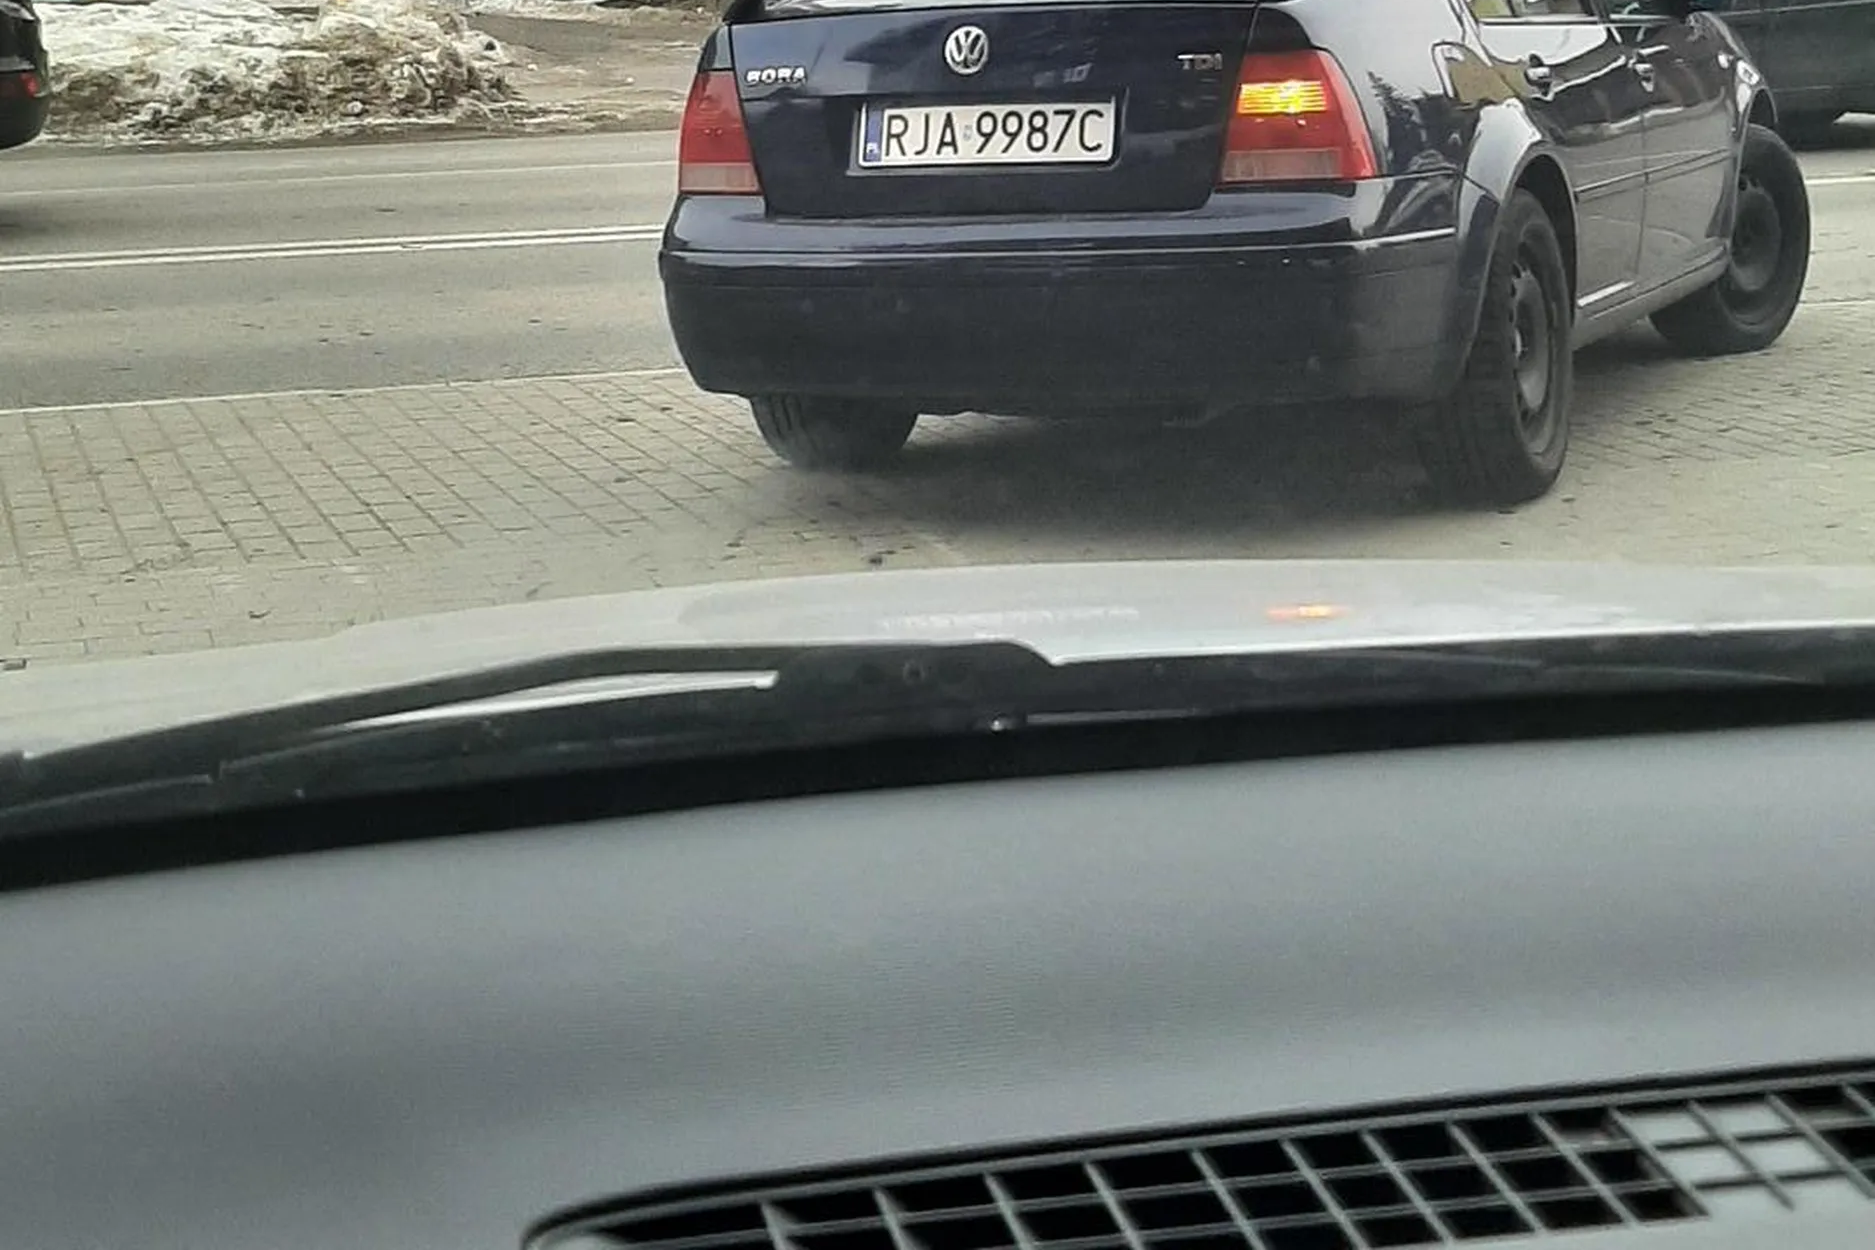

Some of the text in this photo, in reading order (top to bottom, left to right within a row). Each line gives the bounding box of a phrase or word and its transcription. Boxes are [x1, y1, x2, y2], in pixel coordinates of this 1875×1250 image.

[1177, 53, 1222, 70] TDI
[746, 66, 806, 85] BORA
[885, 109, 1105, 157] RJA 9987C
